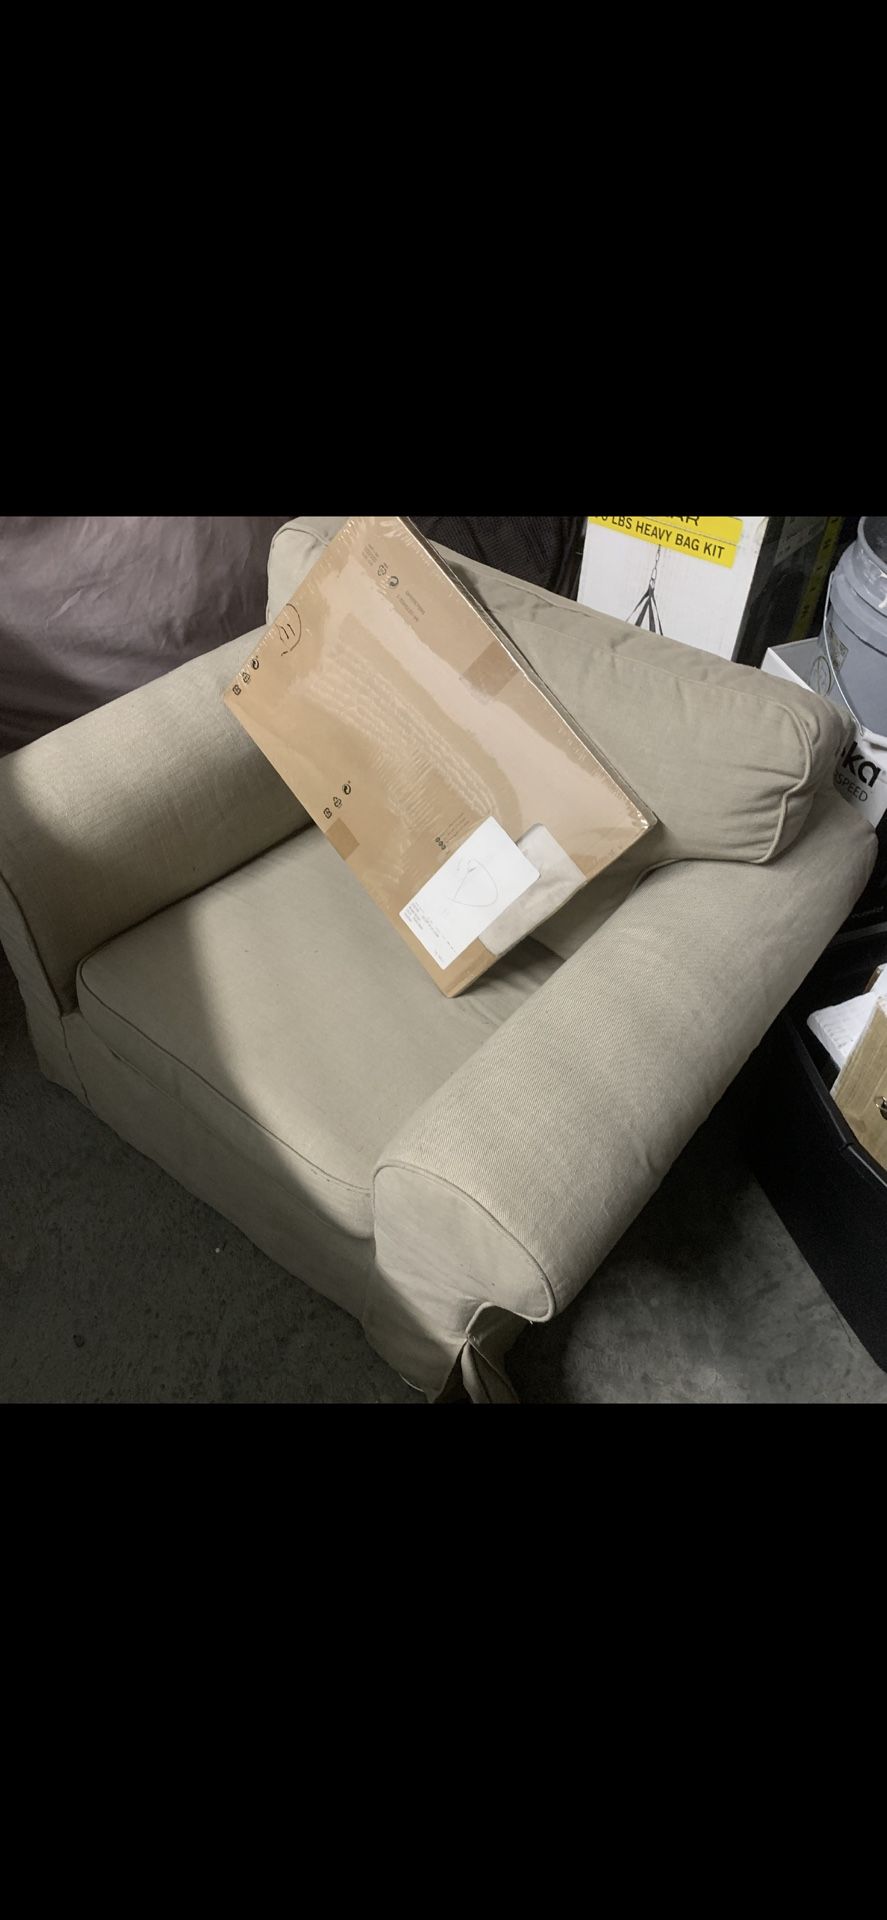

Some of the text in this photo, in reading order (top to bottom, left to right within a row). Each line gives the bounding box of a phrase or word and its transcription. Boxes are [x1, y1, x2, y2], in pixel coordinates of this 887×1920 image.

[611, 516, 726, 559] LBS HEAVY BAG KIT
[841, 741, 882, 788] ka
[834, 770, 869, 803] SPEED
